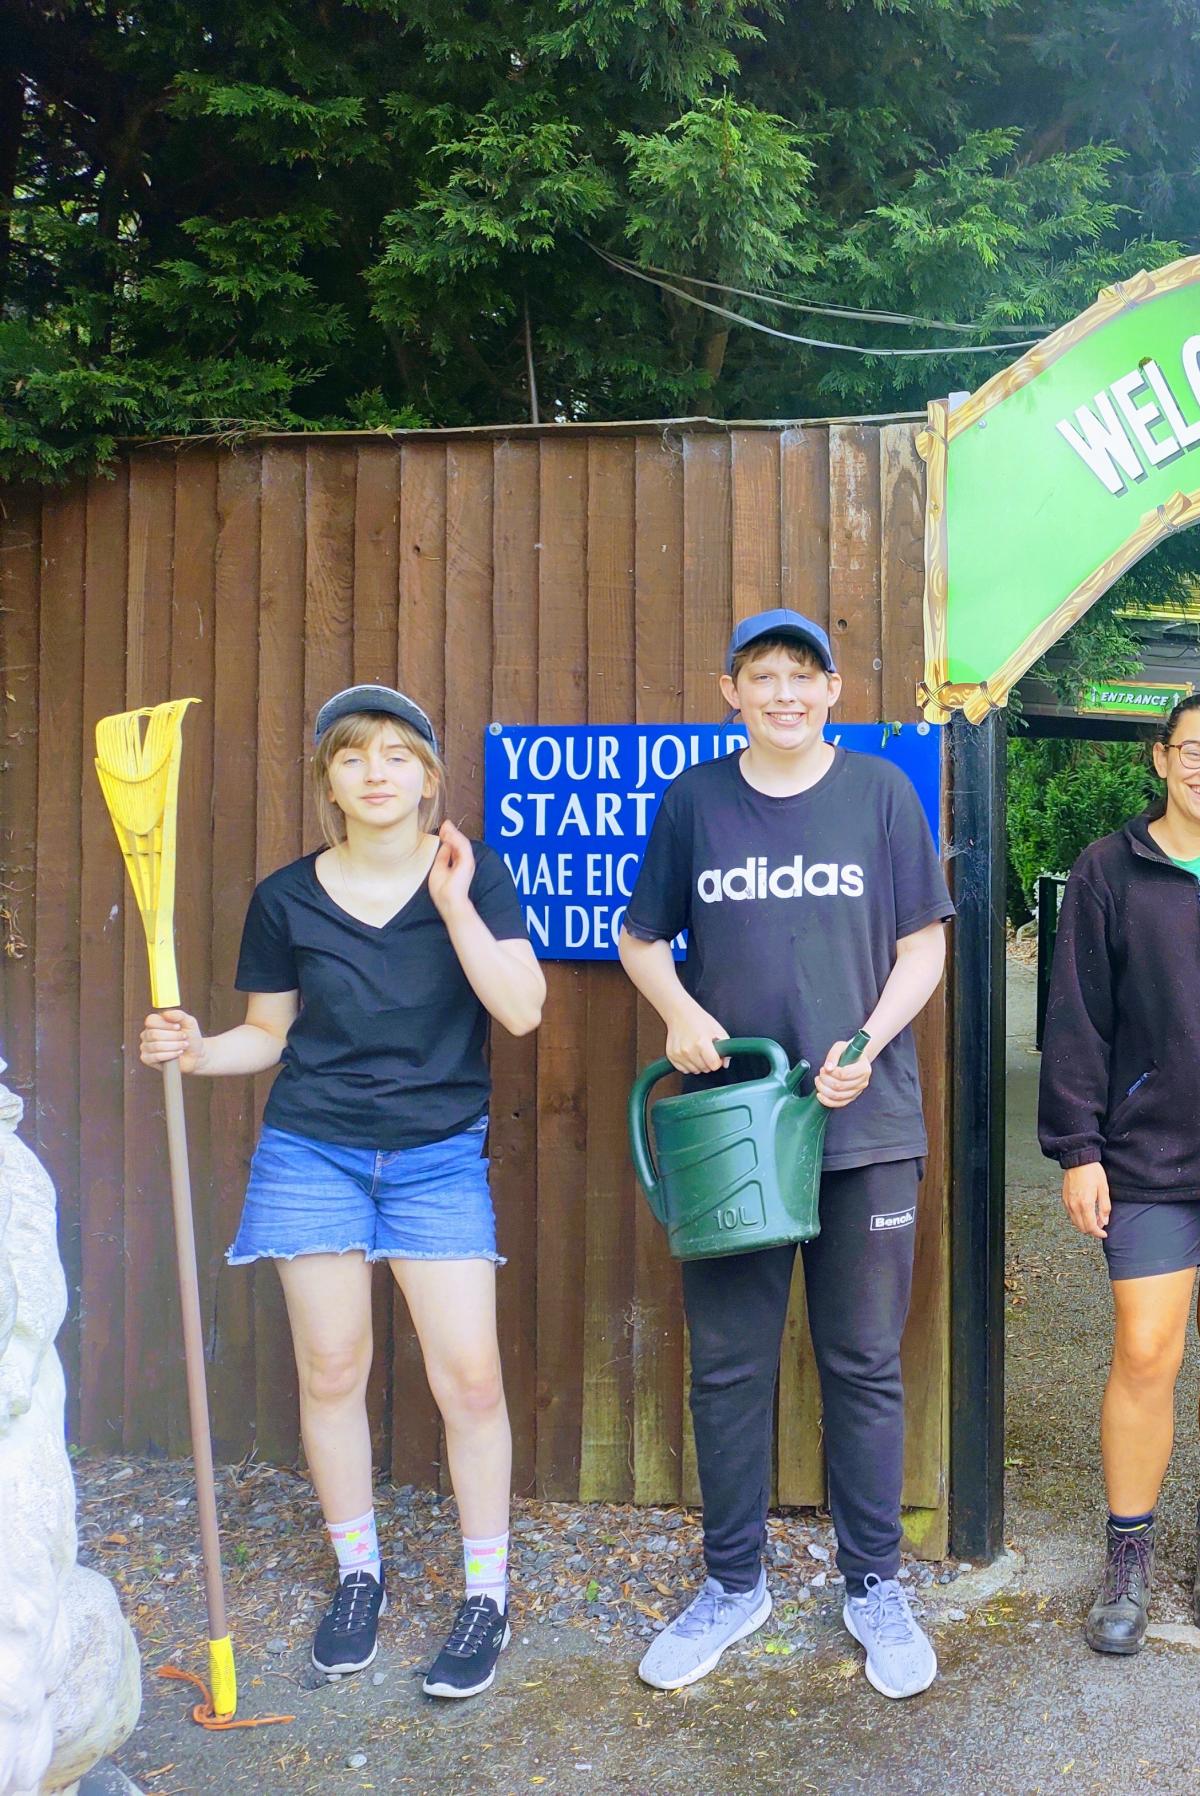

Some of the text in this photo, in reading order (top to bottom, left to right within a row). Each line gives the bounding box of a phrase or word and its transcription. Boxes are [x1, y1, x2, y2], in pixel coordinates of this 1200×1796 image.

[1100, 691, 1168, 706] ENTRANCE
[501, 735, 621, 781] YOUR
[500, 793, 656, 837] START
[504, 853, 640, 896] MAE EIC
[697, 855, 864, 904] adidas
